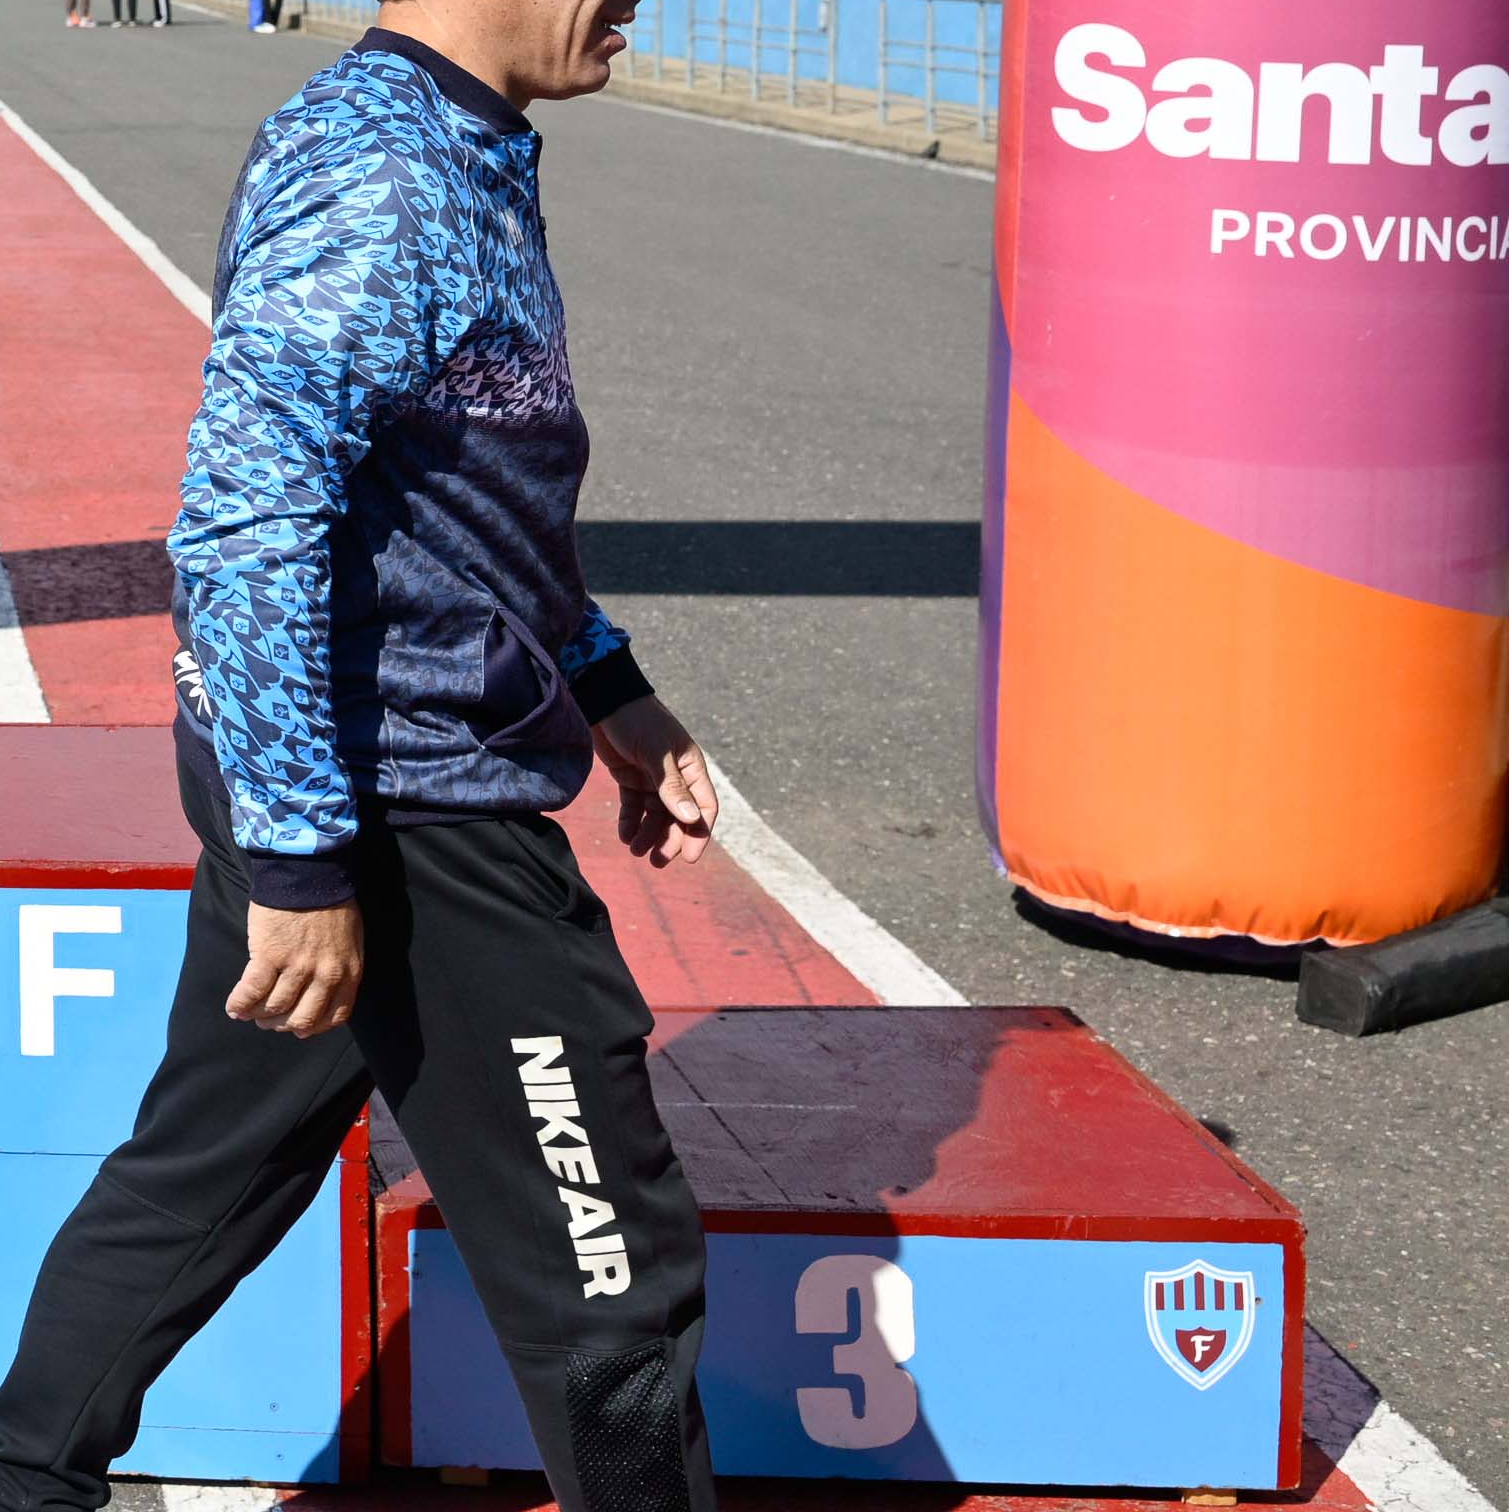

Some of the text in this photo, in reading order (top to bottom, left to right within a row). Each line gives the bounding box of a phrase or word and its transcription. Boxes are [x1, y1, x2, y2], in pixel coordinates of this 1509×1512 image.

[1051, 22, 1509, 167] Santa
[793, 1253, 918, 1450] 3
[1190, 1334, 1216, 1364] F
